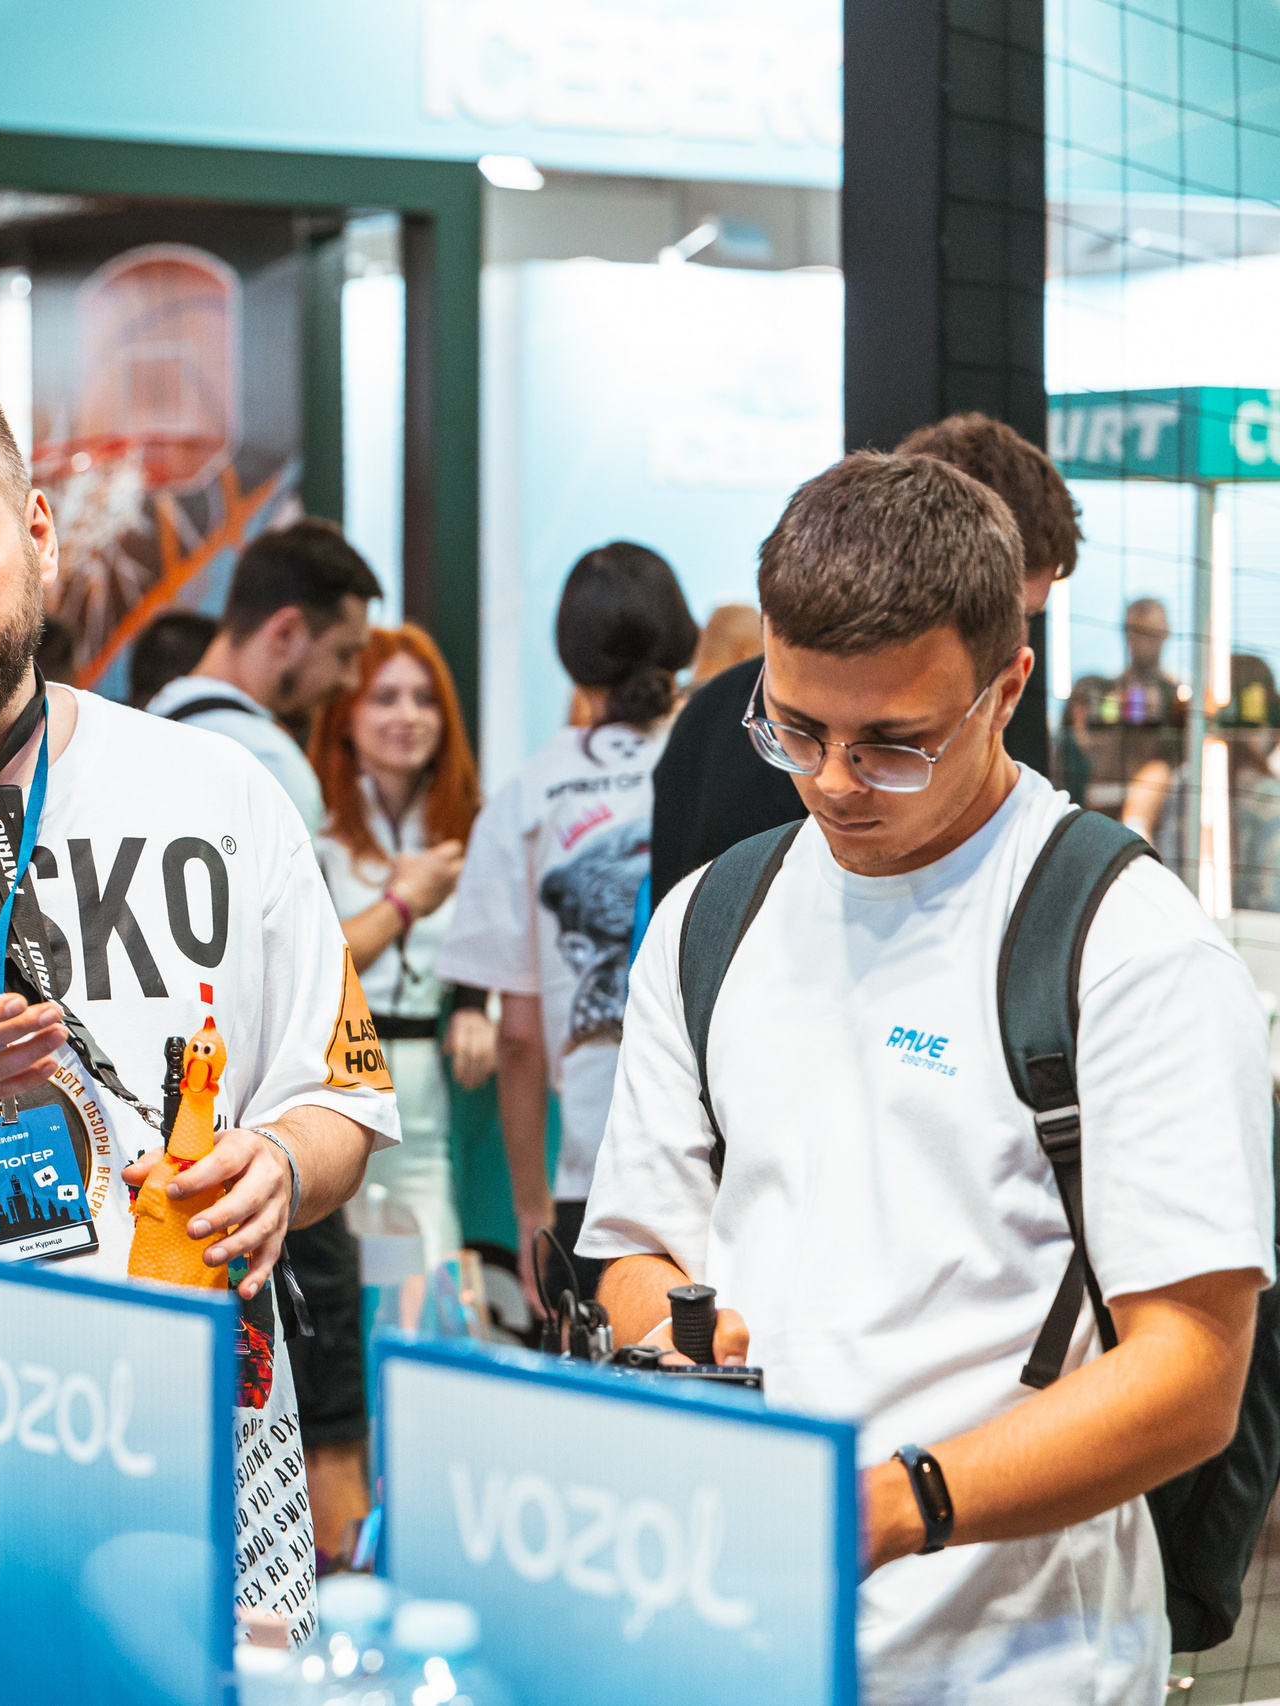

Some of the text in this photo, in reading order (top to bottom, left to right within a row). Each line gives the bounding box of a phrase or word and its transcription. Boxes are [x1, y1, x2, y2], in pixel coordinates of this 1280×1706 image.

[886, 1026, 949, 1058] RAVE
[83, 1100, 111, 1156] ОБЗОРЫ
[35, 1237, 63, 1250] Курица
[265, 1556, 289, 1587] RG
